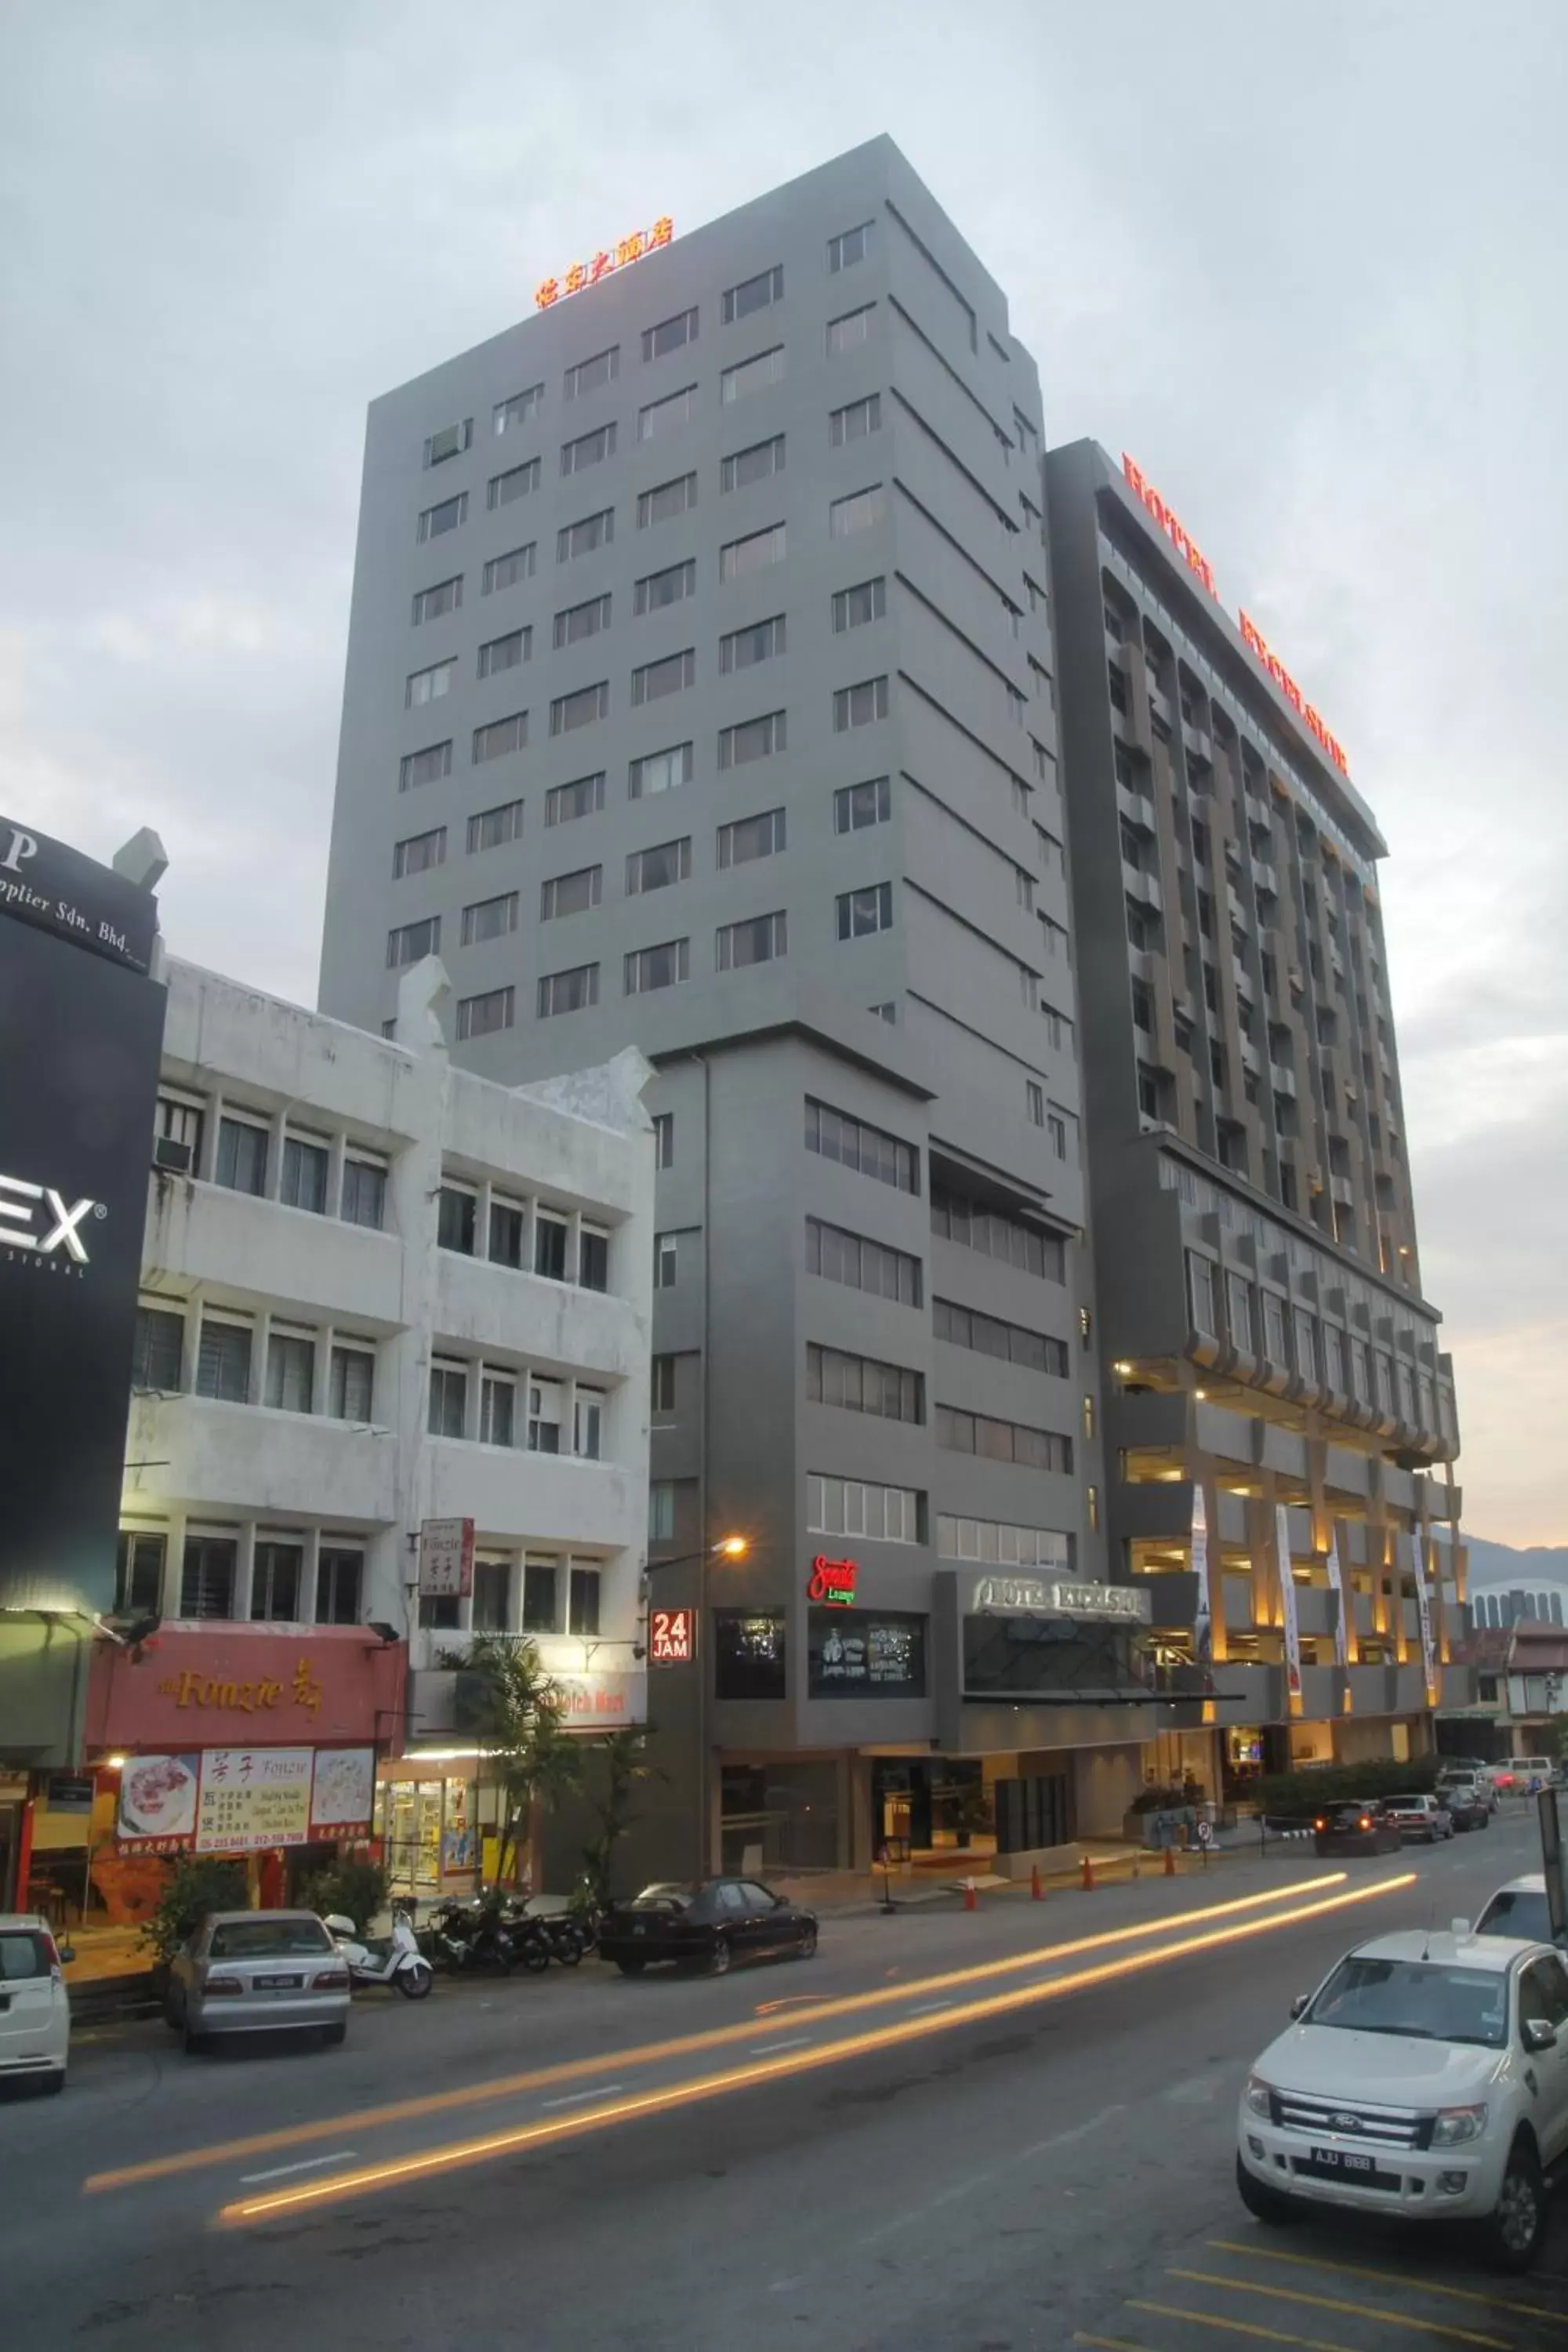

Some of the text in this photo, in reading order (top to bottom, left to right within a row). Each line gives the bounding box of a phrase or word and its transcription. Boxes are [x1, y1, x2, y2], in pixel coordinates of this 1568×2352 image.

[55, 902, 91, 933] Sdn.
[98, 921, 131, 953] Bhd.
[653, 1612, 688, 1641] 24
[653, 1639, 688, 1657] JAM
